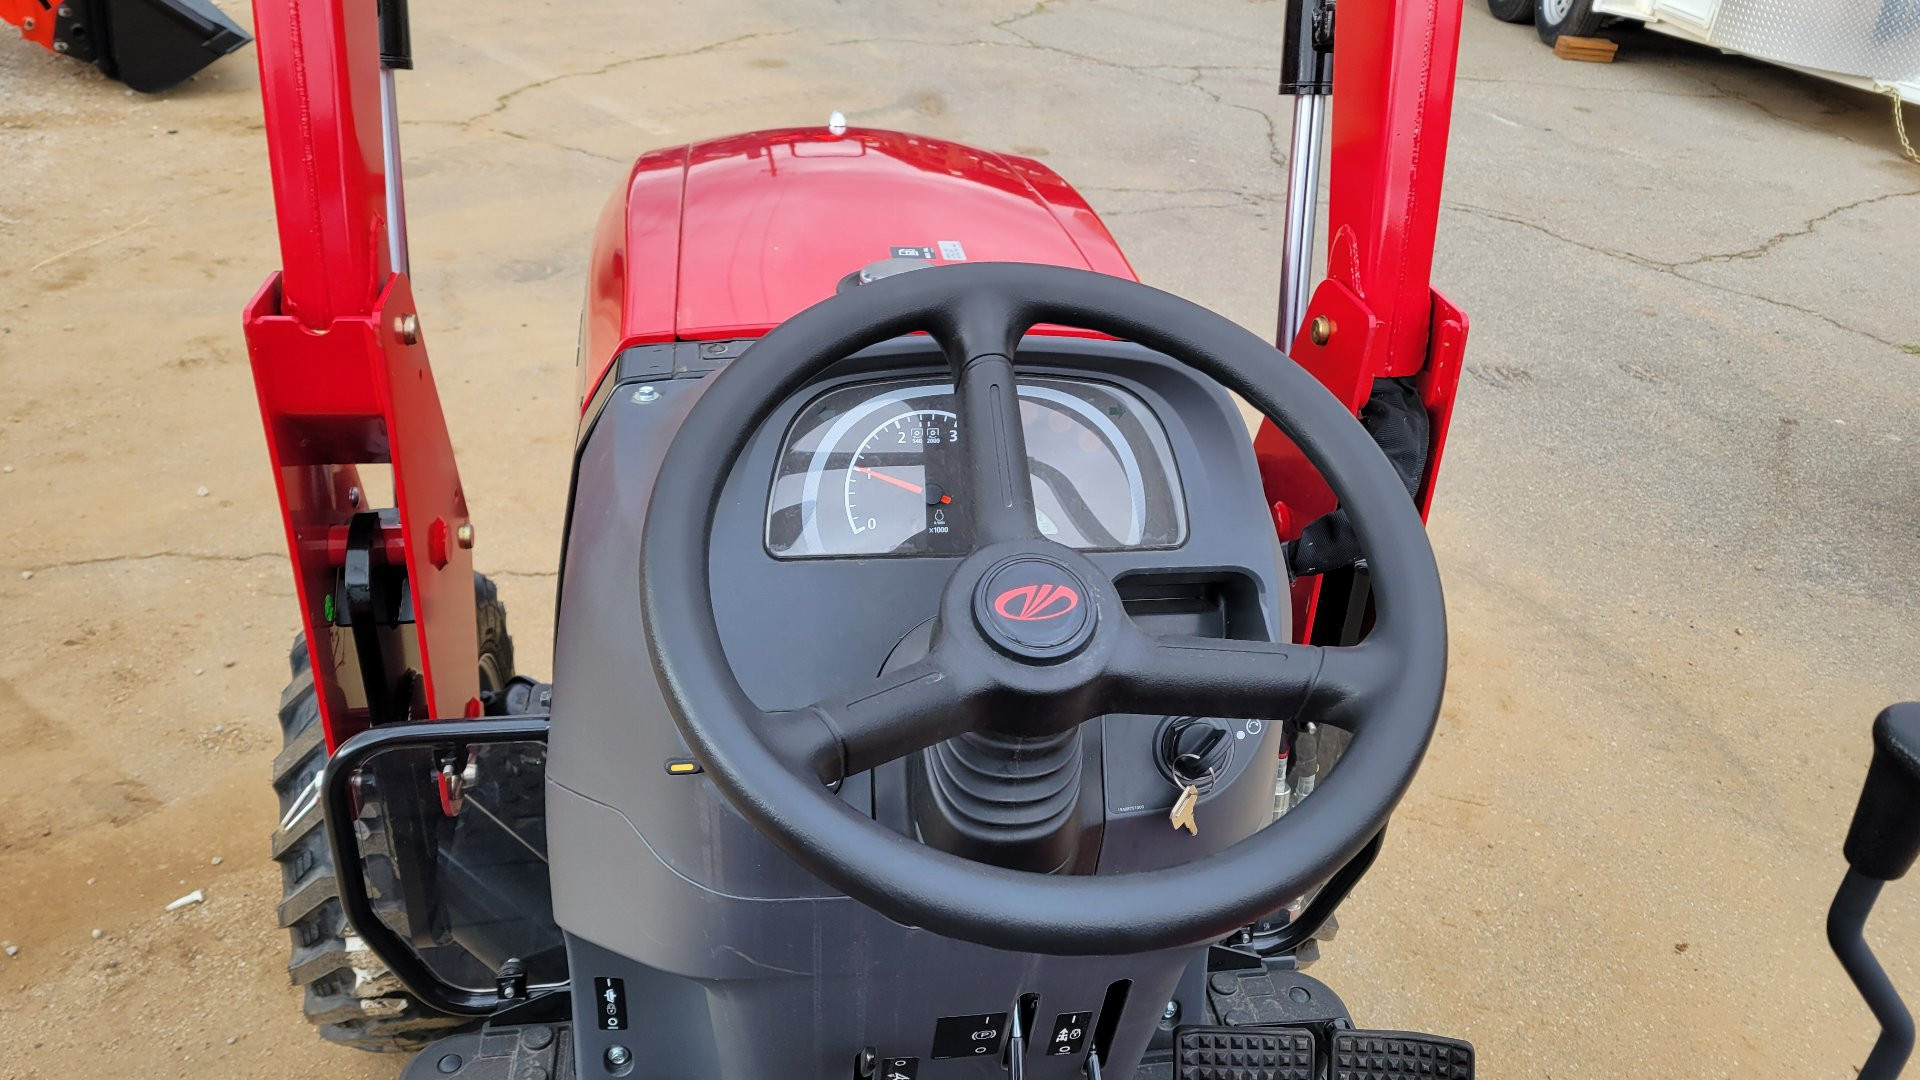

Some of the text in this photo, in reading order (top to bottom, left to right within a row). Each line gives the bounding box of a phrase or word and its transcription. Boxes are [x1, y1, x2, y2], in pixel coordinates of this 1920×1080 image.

[898, 432, 906, 444] 2
[950, 430, 958, 442] 3
[868, 518, 876, 530] 0
